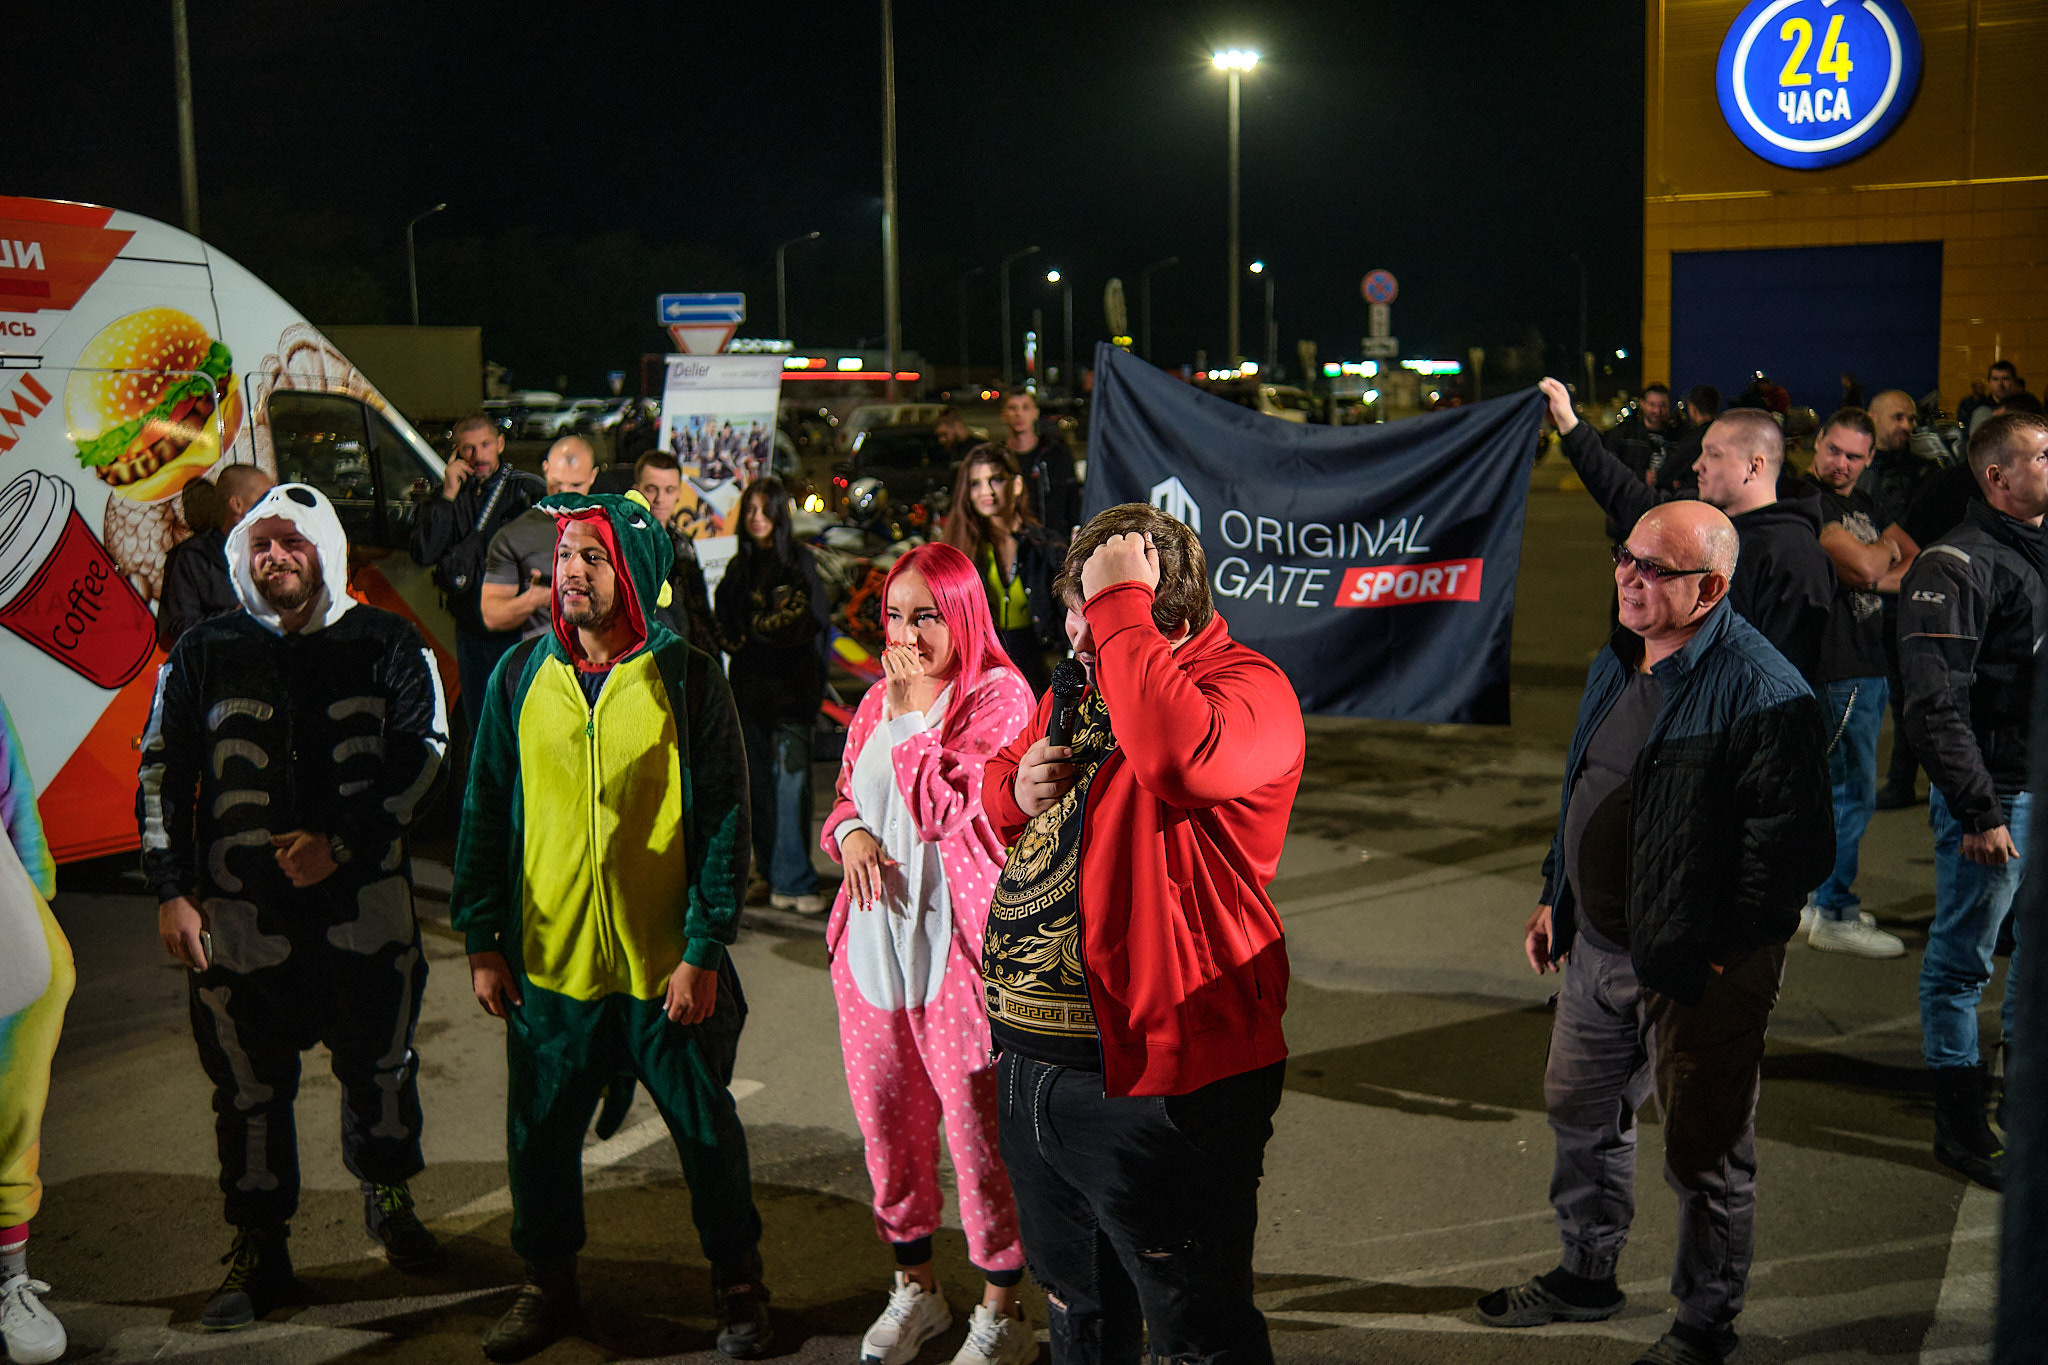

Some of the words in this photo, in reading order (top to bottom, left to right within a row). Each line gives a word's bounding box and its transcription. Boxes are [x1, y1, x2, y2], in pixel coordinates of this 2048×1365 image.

[1779, 15, 1853, 86] 24
[1778, 87, 1852, 124] ЧАСА
[1219, 510, 1430, 558] ORIGINAL
[53, 560, 109, 650] Coffee
[1214, 556, 1331, 607] GATE
[1351, 564, 1467, 601] SPORT
